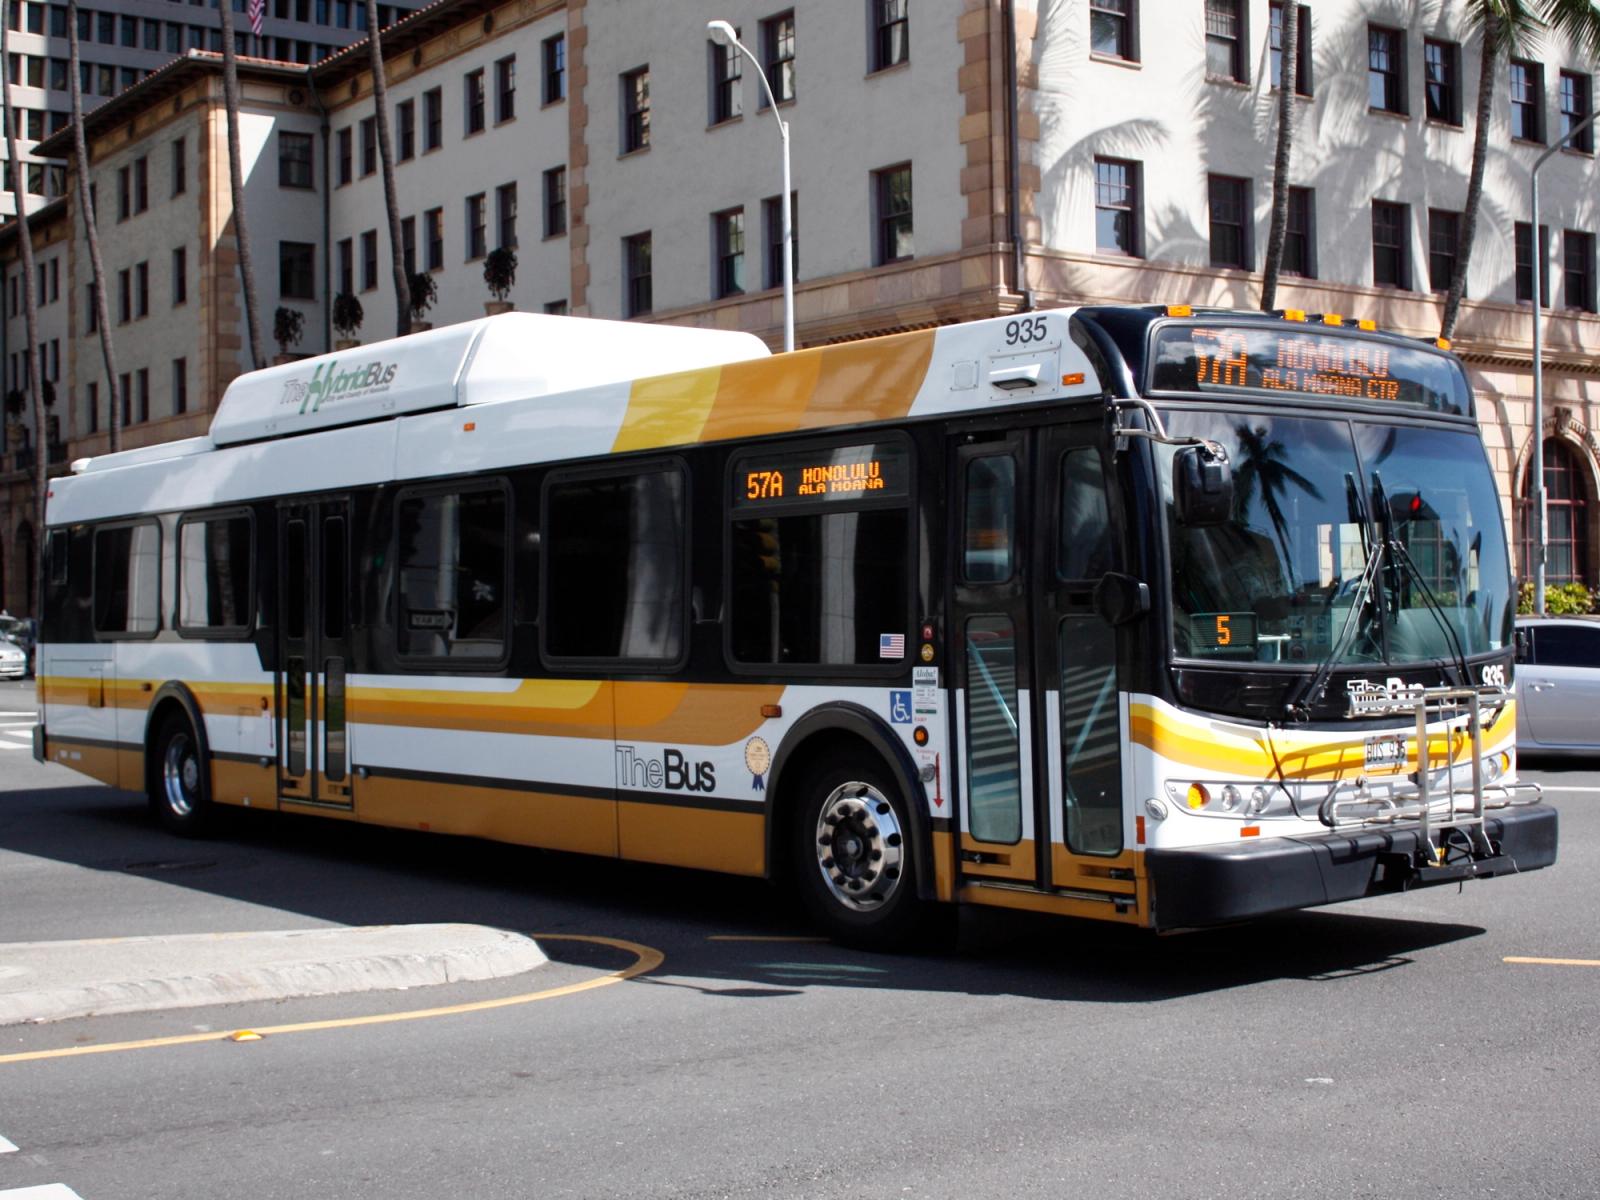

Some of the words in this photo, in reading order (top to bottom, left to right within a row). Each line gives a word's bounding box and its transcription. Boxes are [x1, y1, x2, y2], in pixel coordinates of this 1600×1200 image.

[1006, 316, 1047, 345] 935
[1276, 338, 1389, 378] HONOLULU
[1262, 368, 1297, 390] ALA
[1303, 373, 1362, 397] MOANA
[1367, 379, 1399, 400] CTR
[747, 471, 783, 499] 57A
[803, 461, 880, 484] HONOLULU
[798, 482, 826, 495] ALA
[831, 478, 884, 492] MOANA
[1216, 615, 1231, 645] 5
[1482, 664, 1504, 687] 935
[1366, 743, 1384, 762] BUS
[1389, 740, 1406, 760] 935
[615, 745, 716, 792] TheBus
